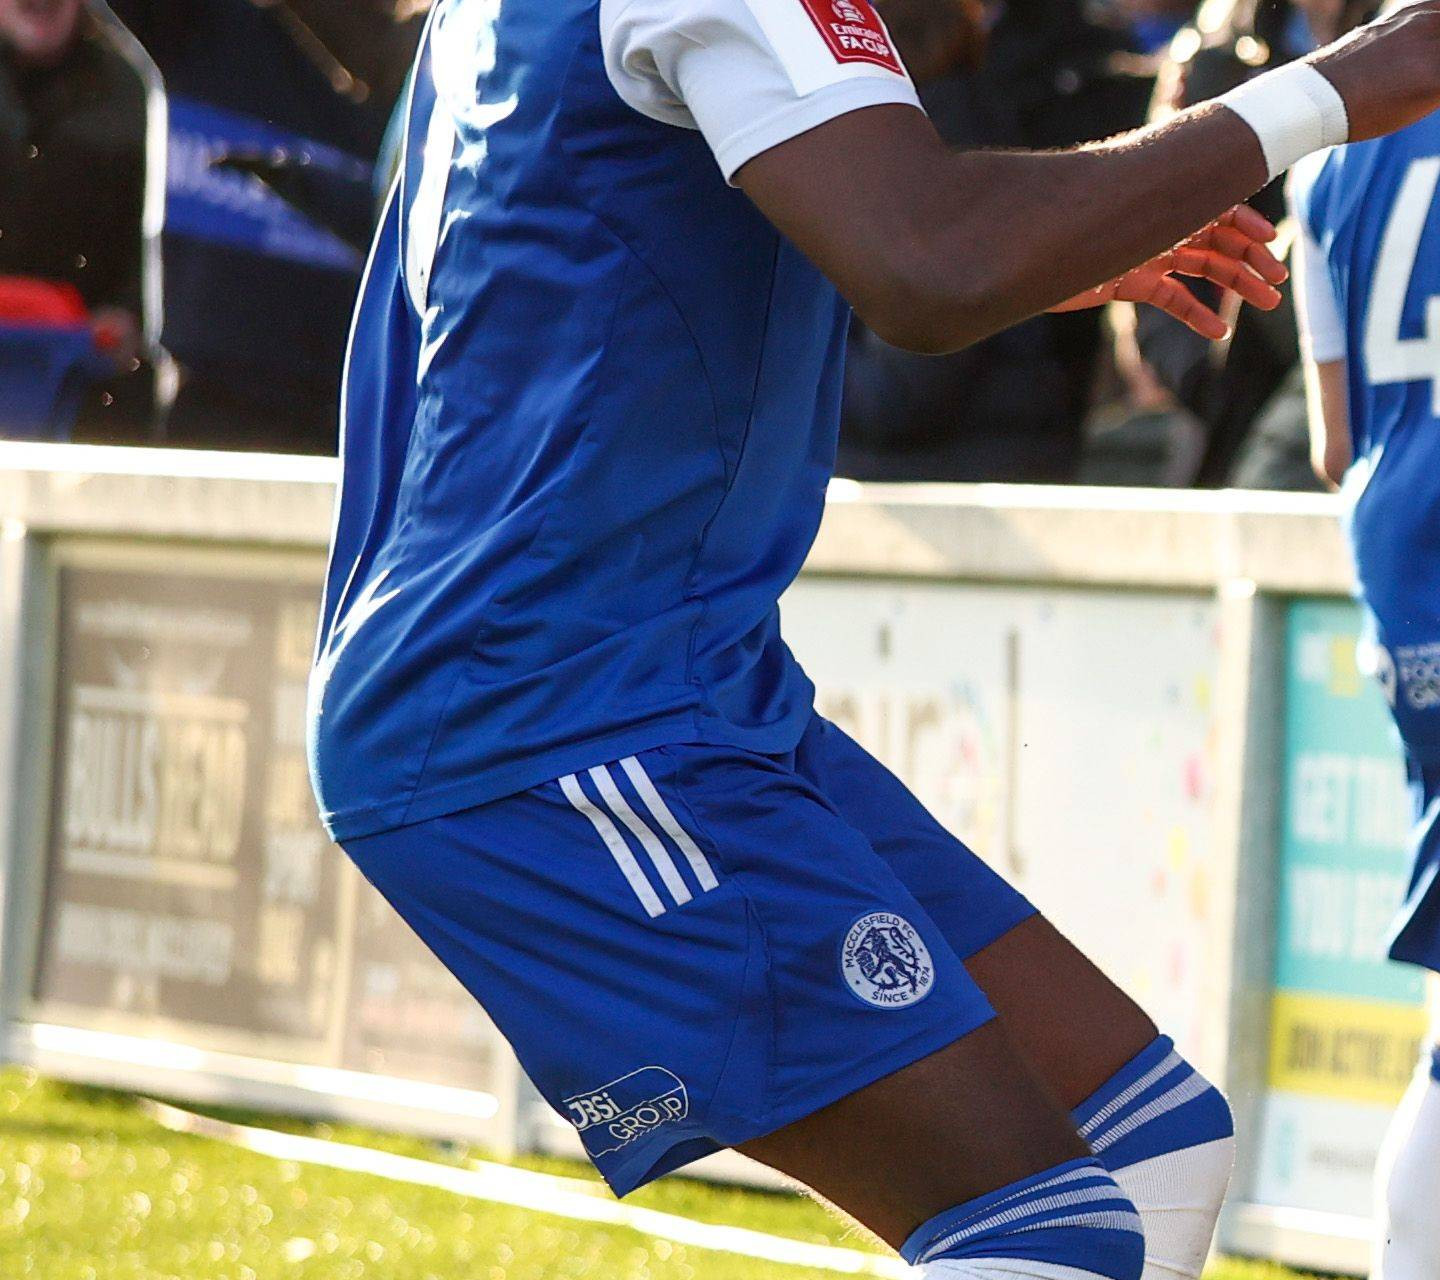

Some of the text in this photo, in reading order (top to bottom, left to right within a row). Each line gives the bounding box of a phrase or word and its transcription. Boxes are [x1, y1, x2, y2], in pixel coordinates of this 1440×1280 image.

[838, 35, 864, 50] FA
[844, 914, 916, 969] MACCLESFIELD FC
[871, 965, 931, 1004] SINCE 1874
[567, 1089, 621, 1128] JBSi
